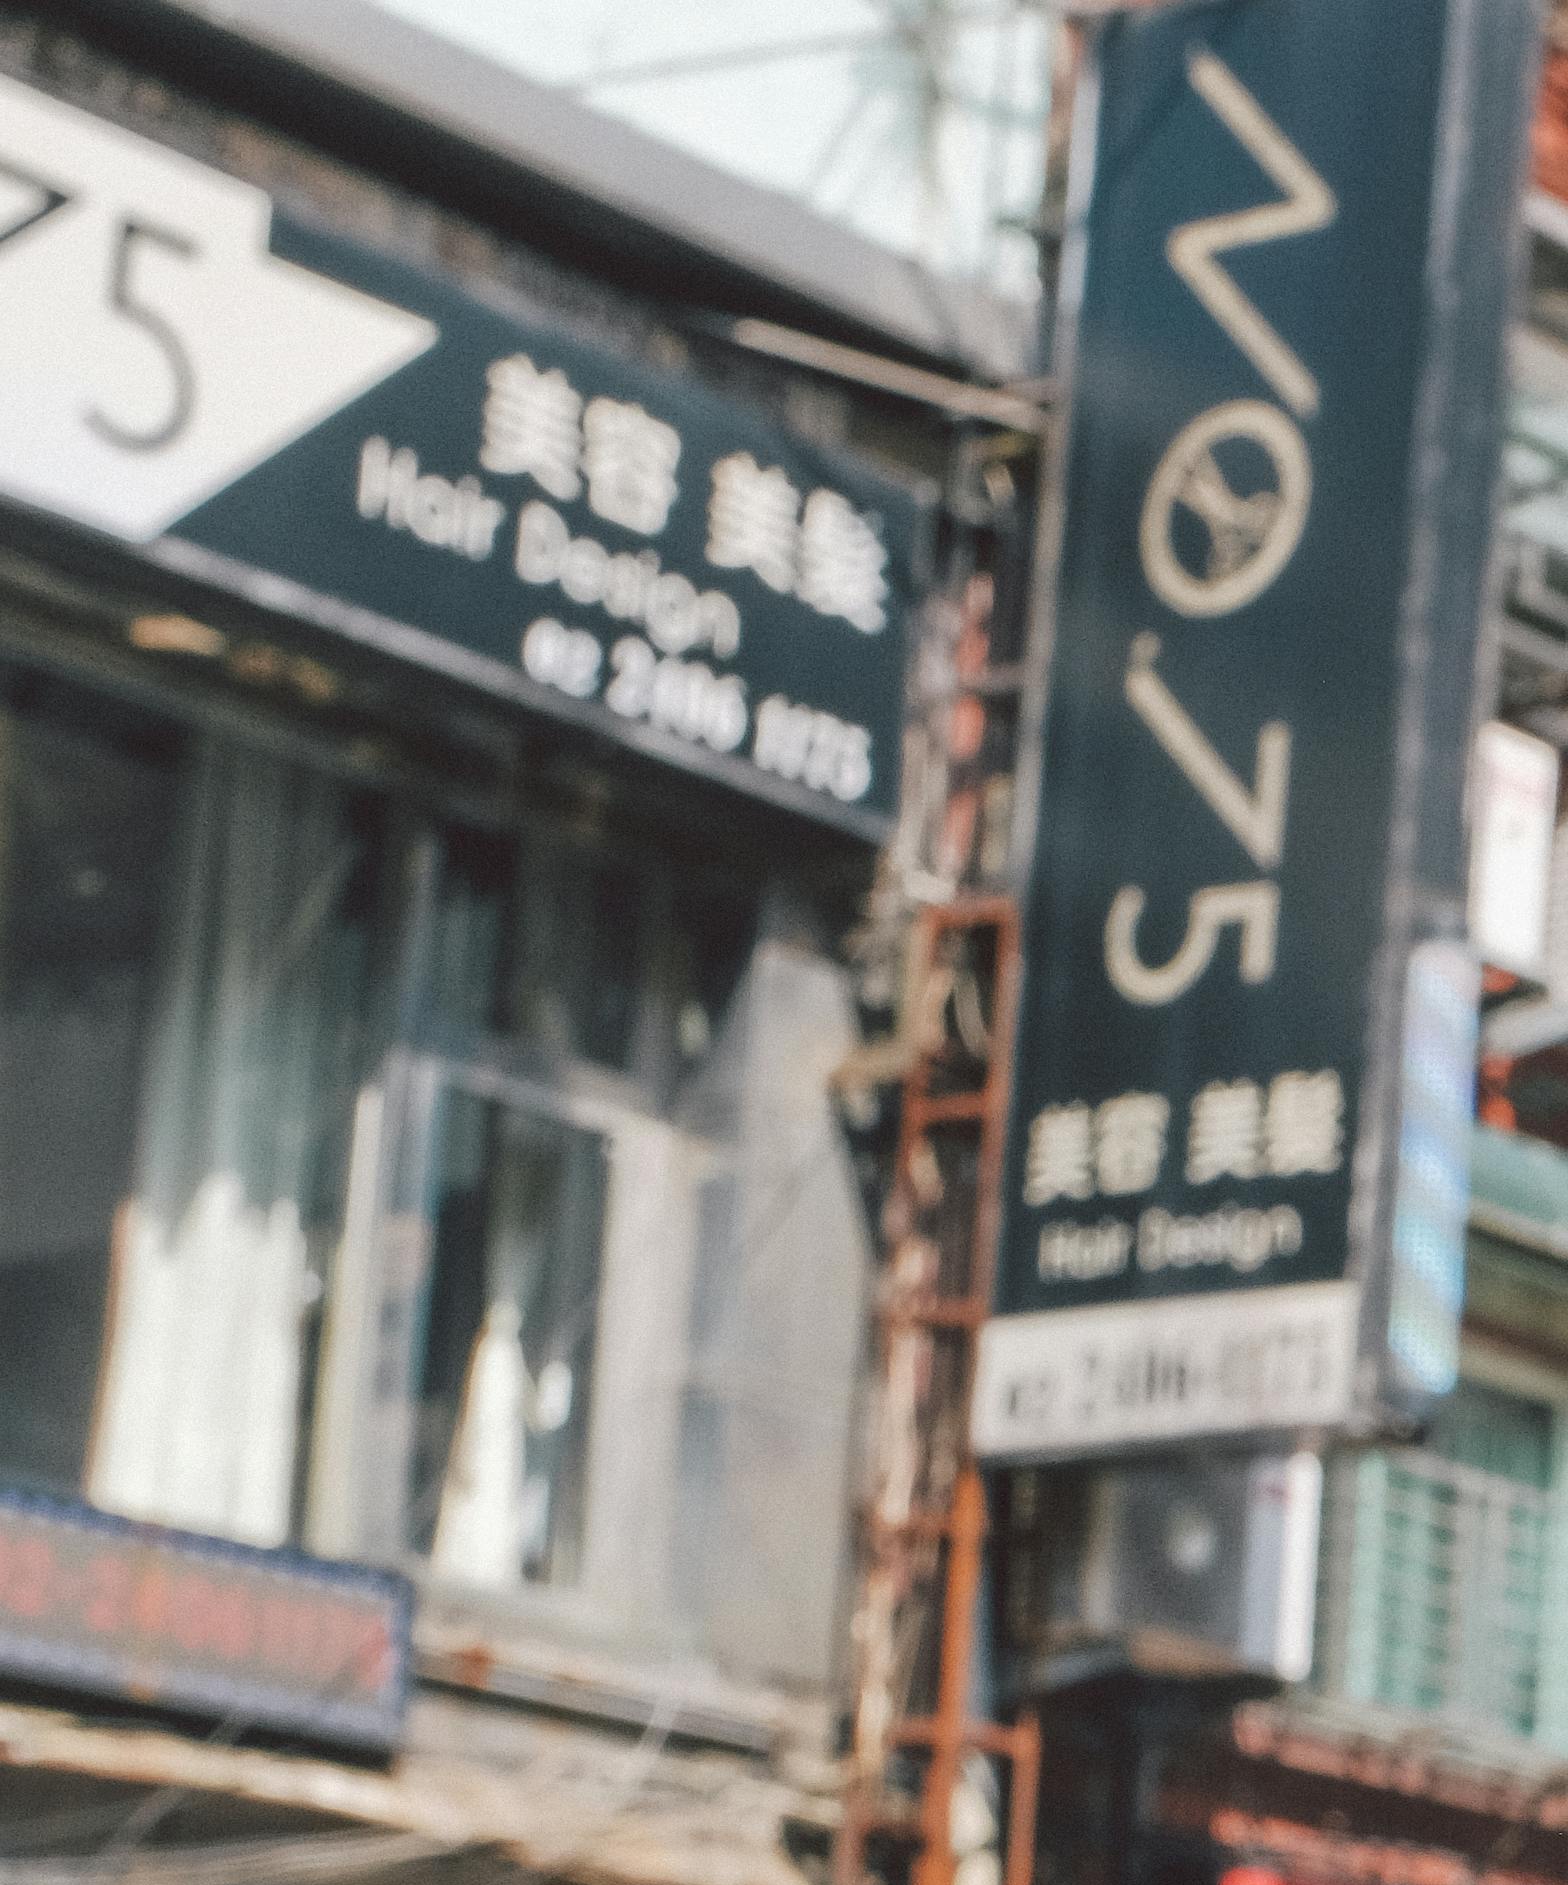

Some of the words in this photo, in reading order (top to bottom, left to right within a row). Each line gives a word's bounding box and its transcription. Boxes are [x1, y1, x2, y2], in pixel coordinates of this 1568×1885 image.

[481, 353, 681, 535] 美容
[356, 436, 506, 560] Hair
[514, 501, 740, 659] Design
[1025, 1092, 1170, 1205] 美容
[1037, 1217, 1134, 1282] Hair
[1136, 1205, 1301, 1272] Design
